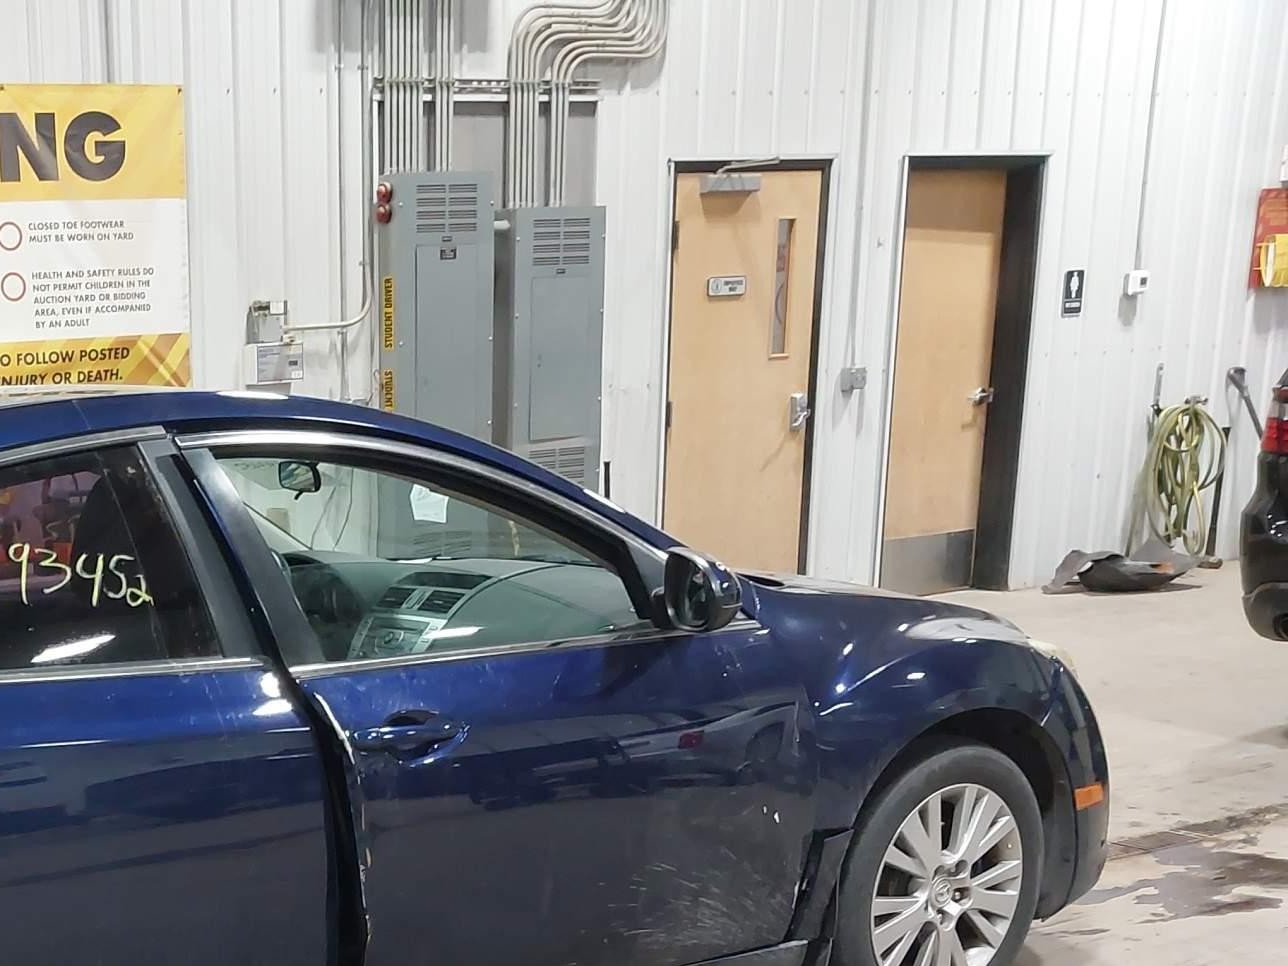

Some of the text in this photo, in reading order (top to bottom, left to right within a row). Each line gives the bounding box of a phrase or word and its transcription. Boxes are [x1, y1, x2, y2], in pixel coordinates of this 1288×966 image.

[28, 220, 125, 231] CLOSED TOE FOOTWEAR
[28, 232, 134, 243] MUST BE WORN ON YARD
[32, 267, 154, 280] HEALTH AND SAFETY RULES DO
[32, 280, 151, 292] NOT PERMIT CHILDREN IN THE
[34, 292, 146, 304] AUCTION YARD OR BIDDING
[34, 304, 152, 317] AREA, EVEN IF ACCOMPANIED
[384, 278, 392, 348] STUDENT DRIVER
[36, 318, 90, 329] BY AN ADULT
[16, 350, 76, 366] FOLLOW
[80, 346, 130, 362] POSTED
[51, 371, 72, 385] OR
[77, 368, 123, 384] DEATH.
